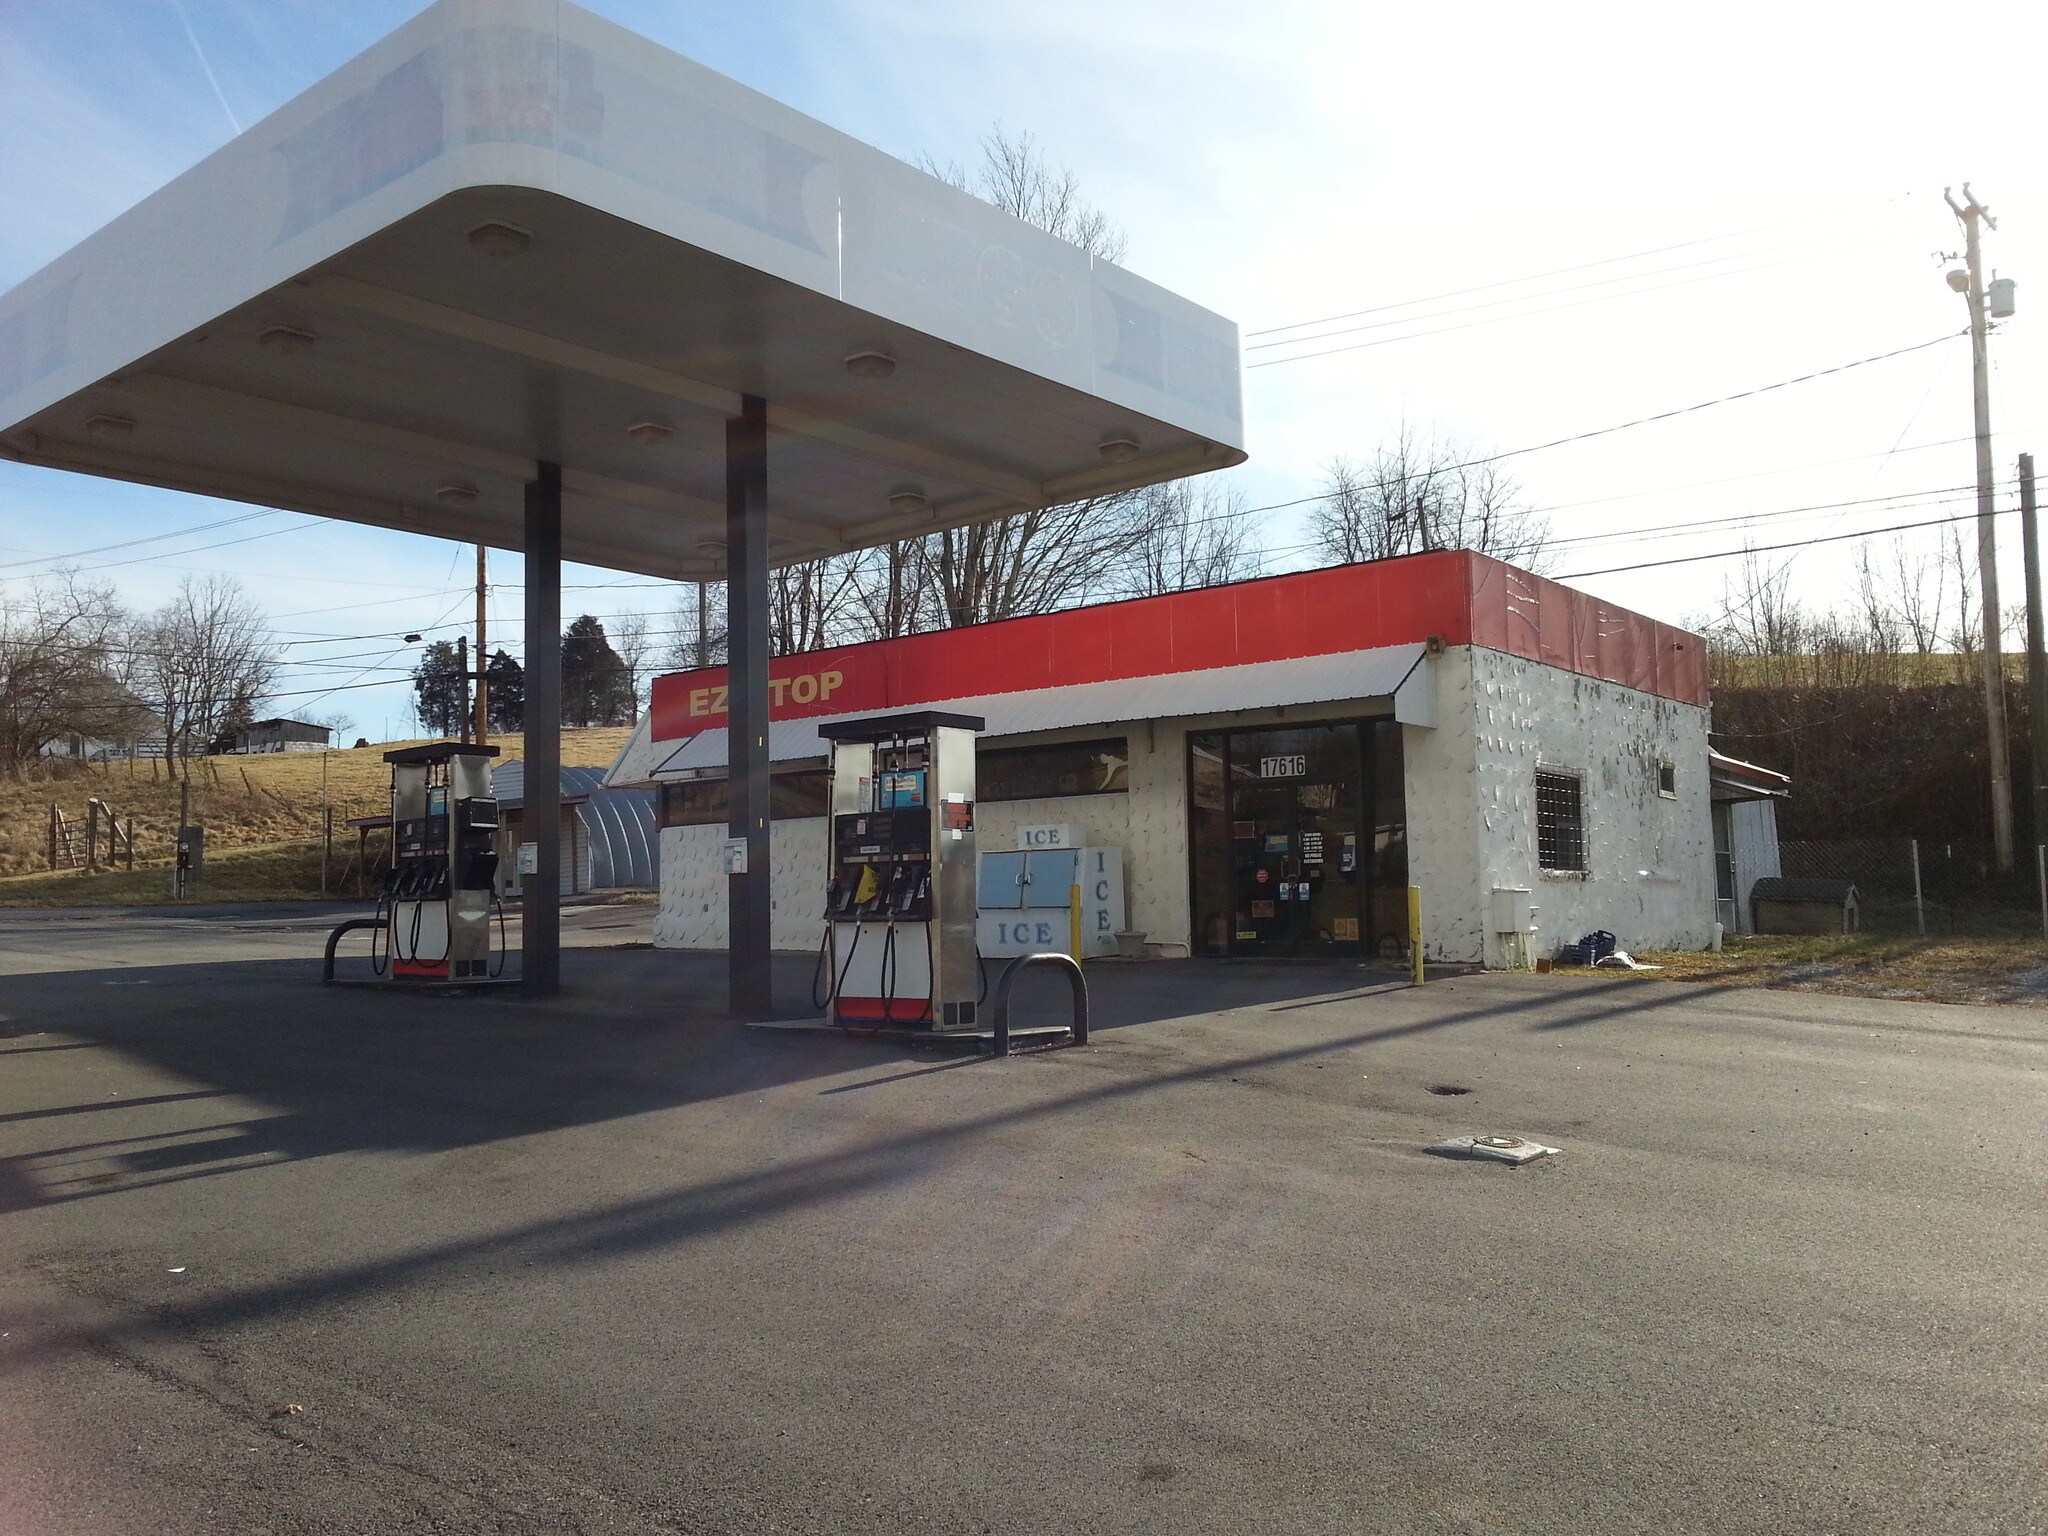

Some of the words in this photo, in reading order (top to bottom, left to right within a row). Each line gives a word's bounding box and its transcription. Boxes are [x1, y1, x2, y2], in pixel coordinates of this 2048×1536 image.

[689, 685, 729, 717] EZ
[769, 670, 844, 707] TOP
[1262, 757, 1304, 777] 17616
[1025, 829, 1060, 845] ICE
[1096, 851, 1111, 931] ICE
[998, 922, 1053, 945] ICE
